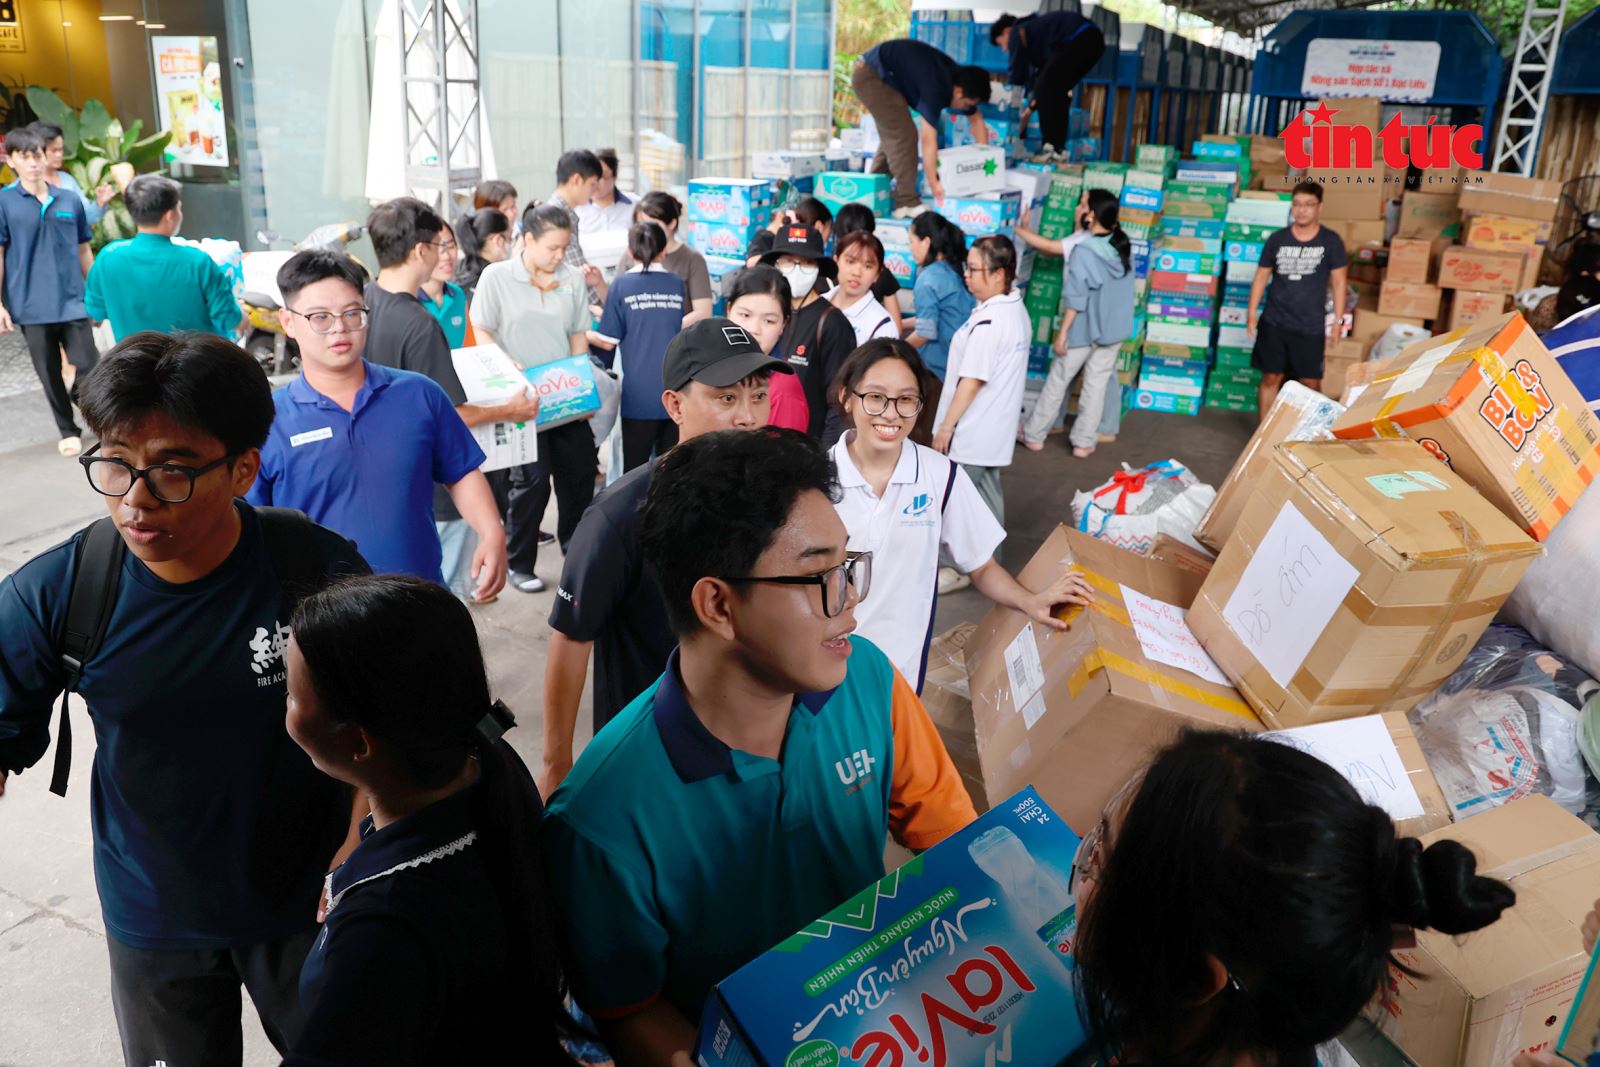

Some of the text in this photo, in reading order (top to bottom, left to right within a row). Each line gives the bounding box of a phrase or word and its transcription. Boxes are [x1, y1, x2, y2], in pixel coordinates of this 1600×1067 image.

[1311, 75, 1332, 86] Nông
[257, 676, 272, 687] FIRE
[1020, 806, 1043, 824] CHAI
[1037, 813, 1050, 825] 24
[808, 890, 955, 992] NƯỚC KHOÁNG THIÊN NHIÊN
[879, 897, 993, 980] Nguyên
[793, 965, 891, 1041] Bản
